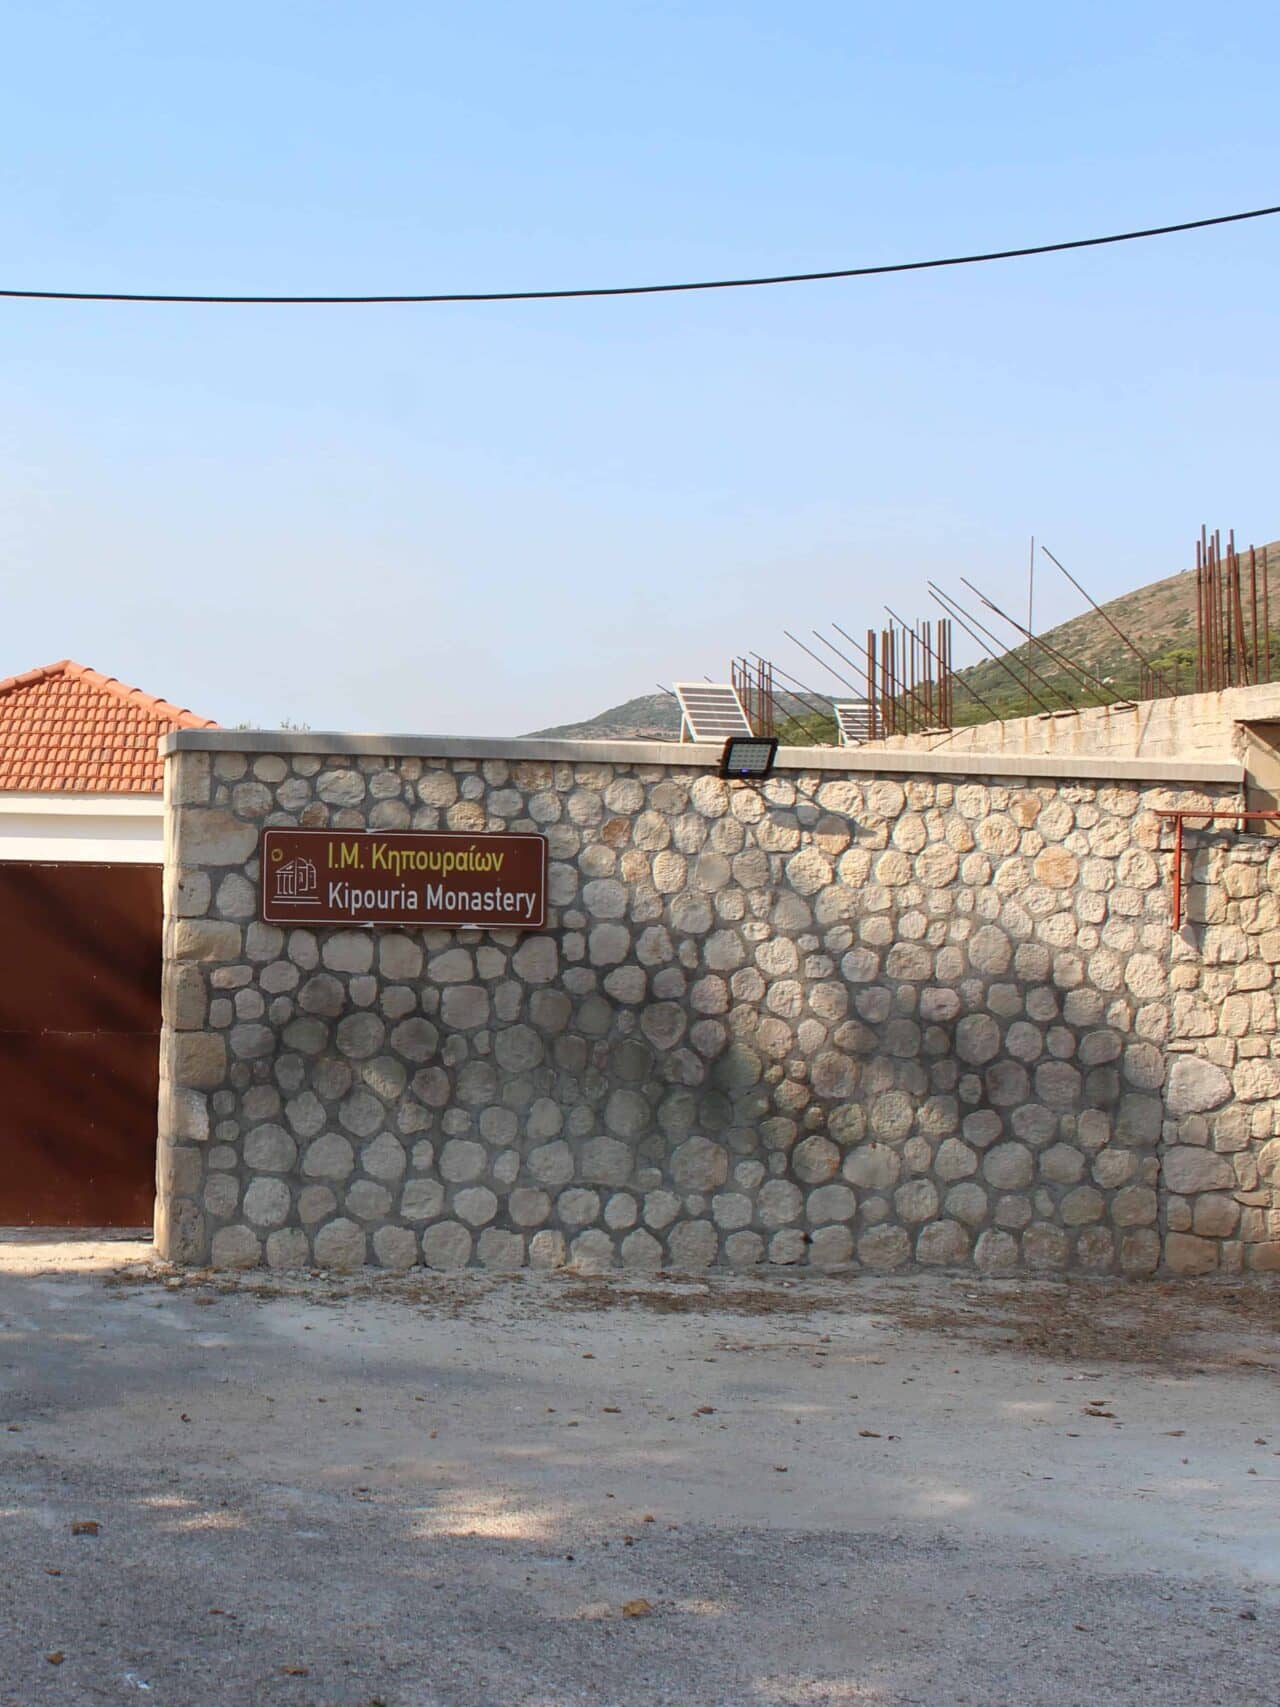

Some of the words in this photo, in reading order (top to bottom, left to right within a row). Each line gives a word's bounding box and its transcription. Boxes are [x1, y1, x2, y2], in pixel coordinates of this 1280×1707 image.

[372, 843, 504, 877] Κηπουραίων
[328, 882, 418, 916] Kipouria
[426, 883, 536, 919] Monastery
